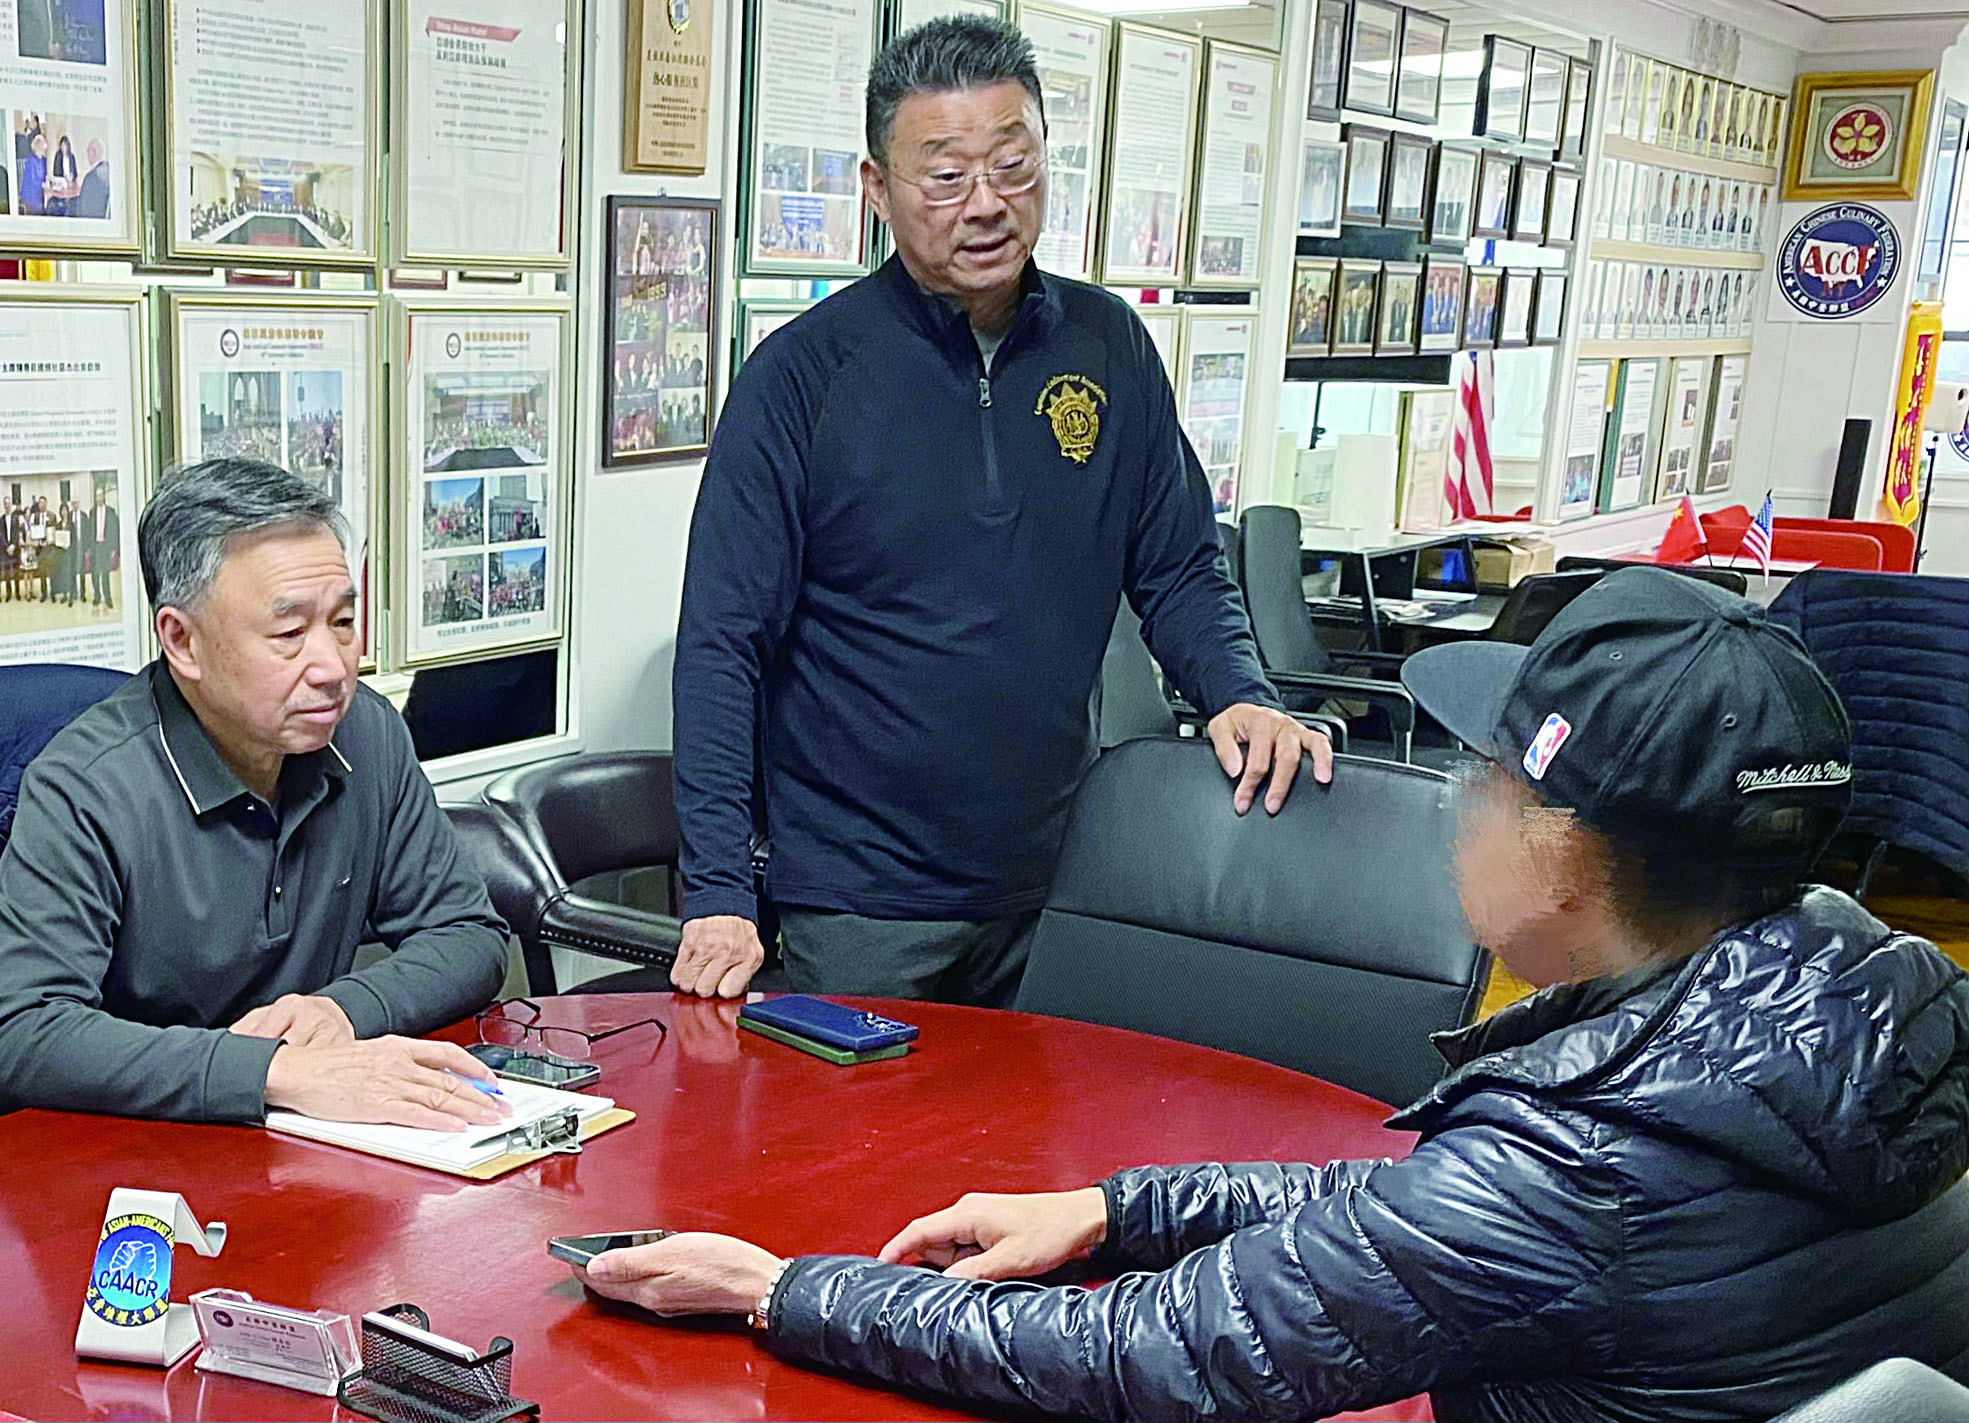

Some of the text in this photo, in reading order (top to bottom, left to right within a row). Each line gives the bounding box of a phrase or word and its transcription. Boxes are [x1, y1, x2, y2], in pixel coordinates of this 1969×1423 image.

[1736, 763, 1813, 789] Mitchell
[1810, 763, 1823, 782] &
[99, 1270, 158, 1299] CAACR
